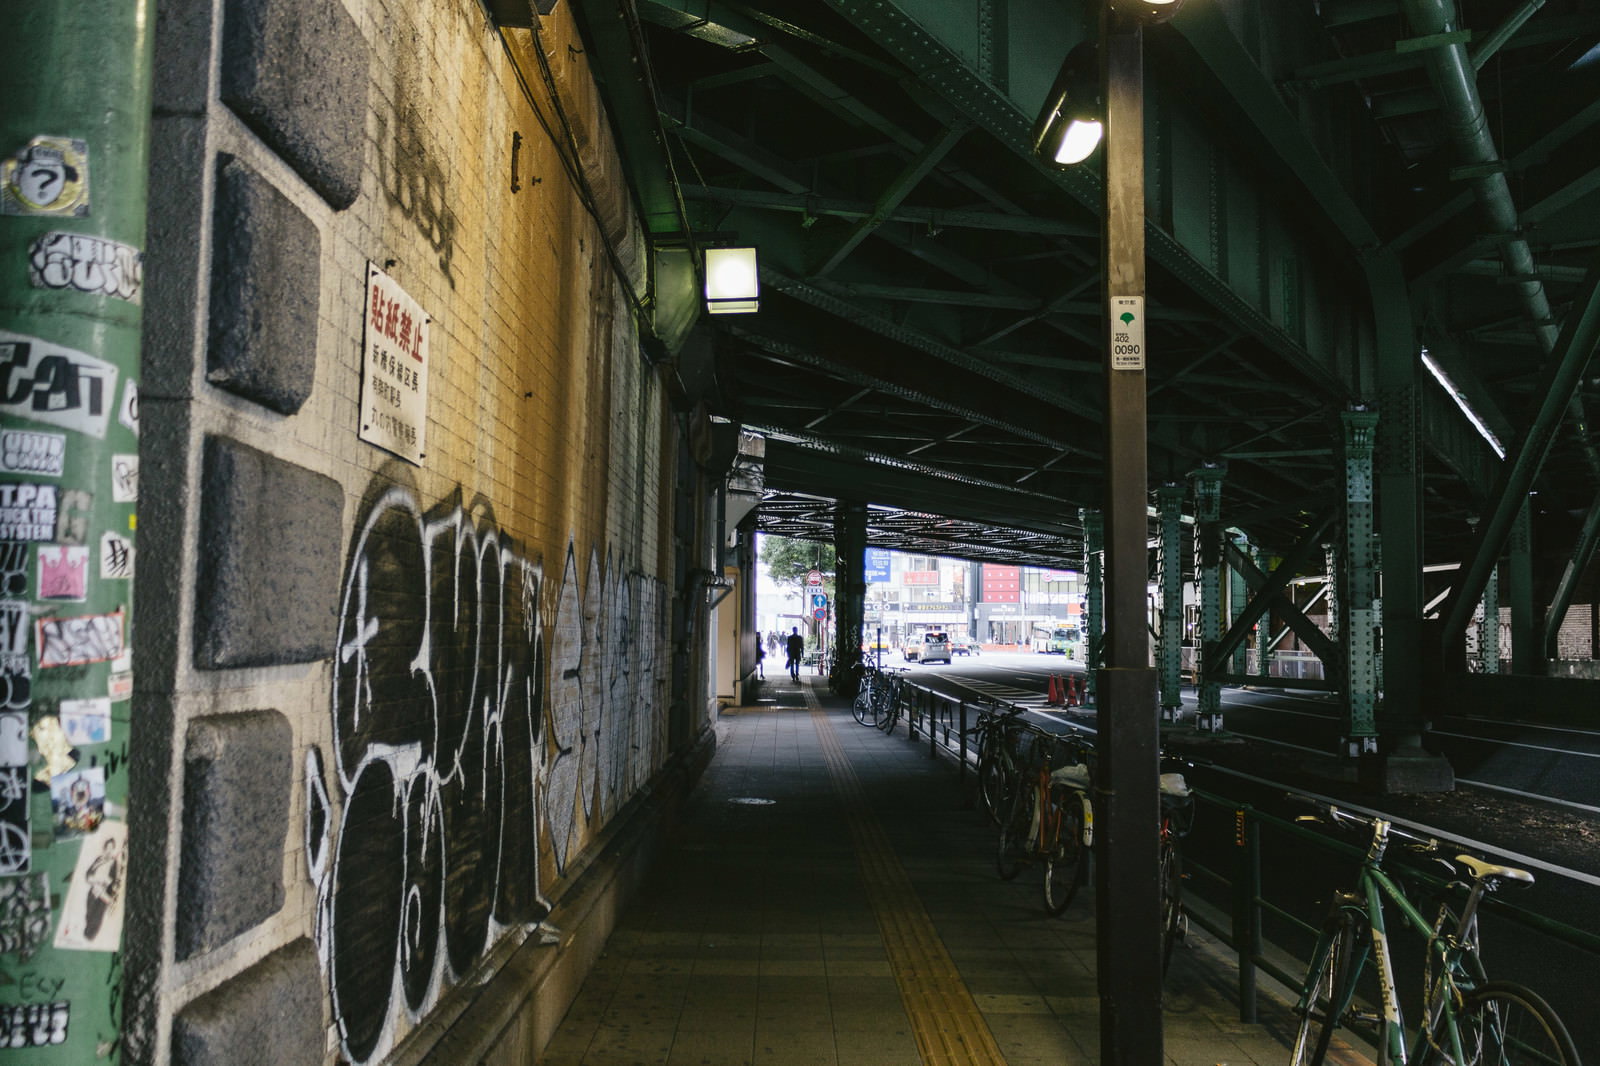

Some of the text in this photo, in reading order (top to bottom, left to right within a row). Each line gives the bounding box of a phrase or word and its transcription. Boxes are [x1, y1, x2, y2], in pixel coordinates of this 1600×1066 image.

[371, 284, 423, 364] 貼紙禁止
[1115, 345, 1140, 355] 0090
[1374, 939, 1393, 1007] Bianchi
